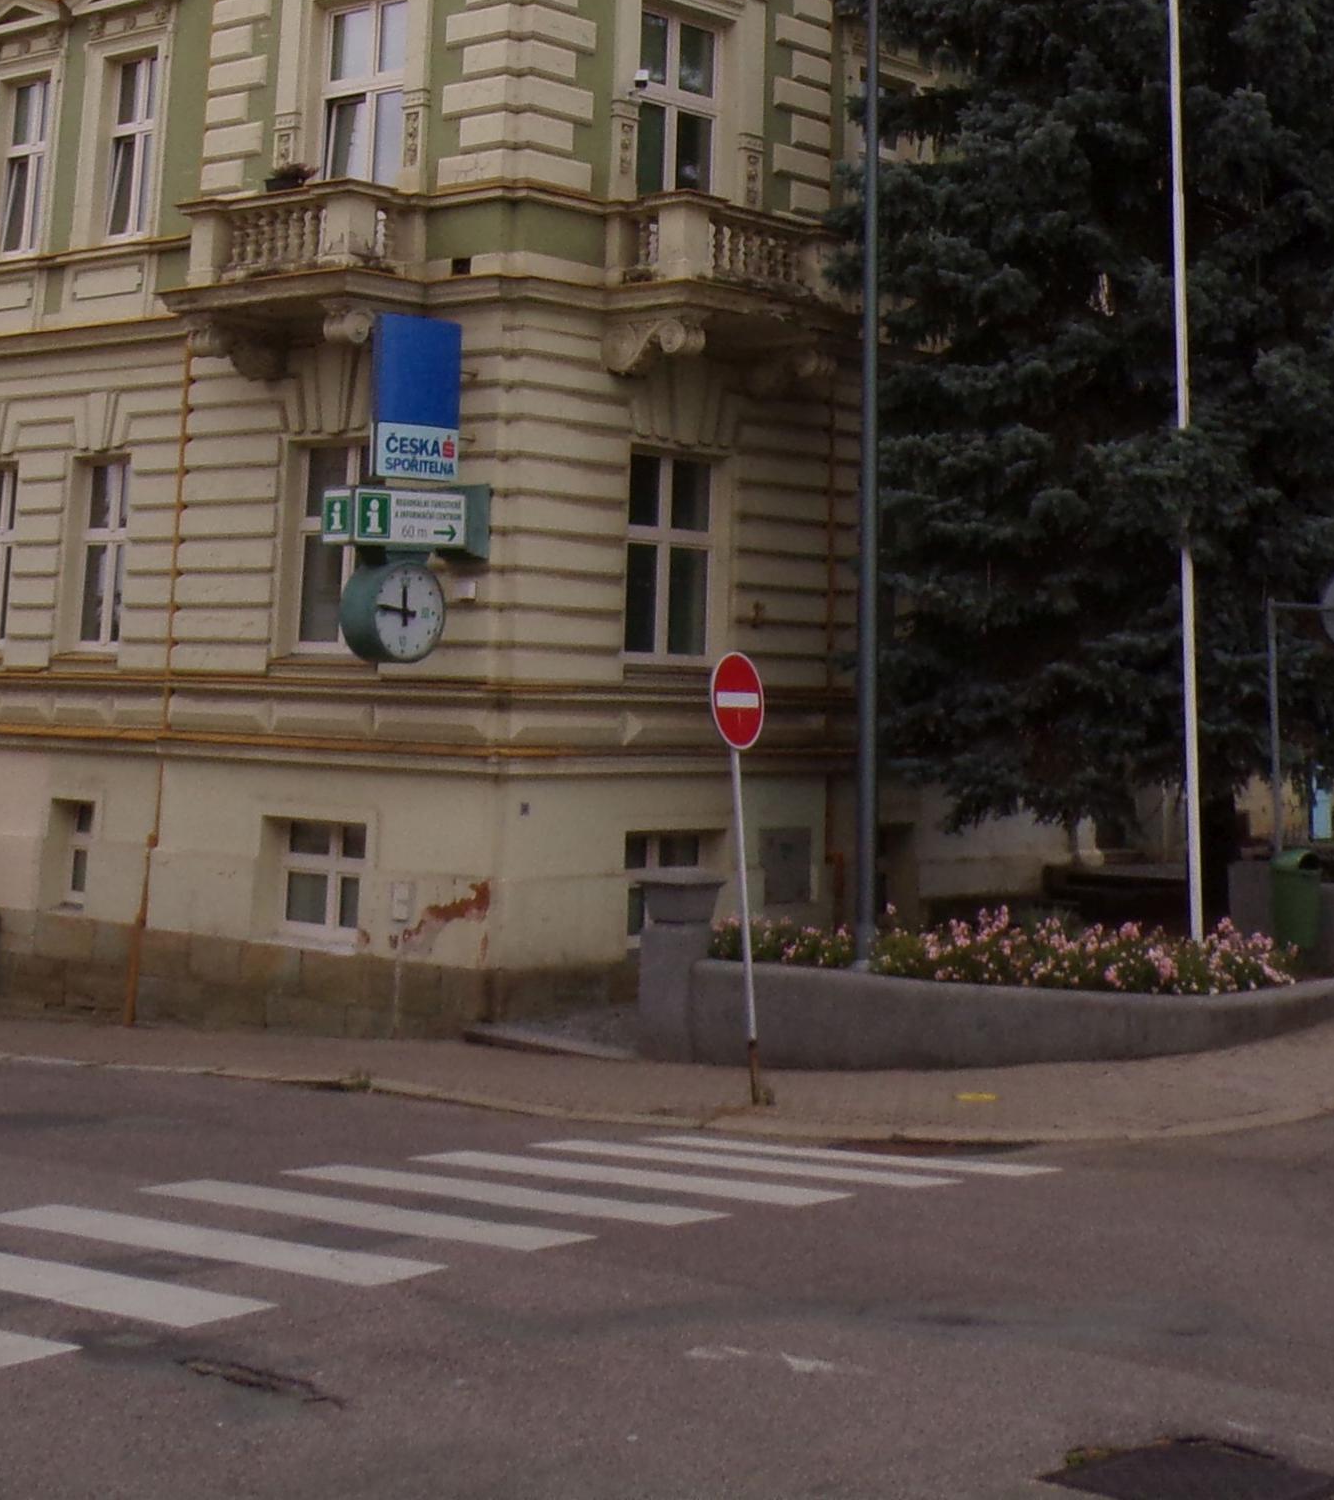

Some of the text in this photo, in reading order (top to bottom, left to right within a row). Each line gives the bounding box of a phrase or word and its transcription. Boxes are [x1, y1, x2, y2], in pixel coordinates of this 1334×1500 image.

[385, 432, 441, 457] ČESKÁ
[385, 456, 455, 476] SPOŘITELNA
[402, 525, 428, 539] 60 m
